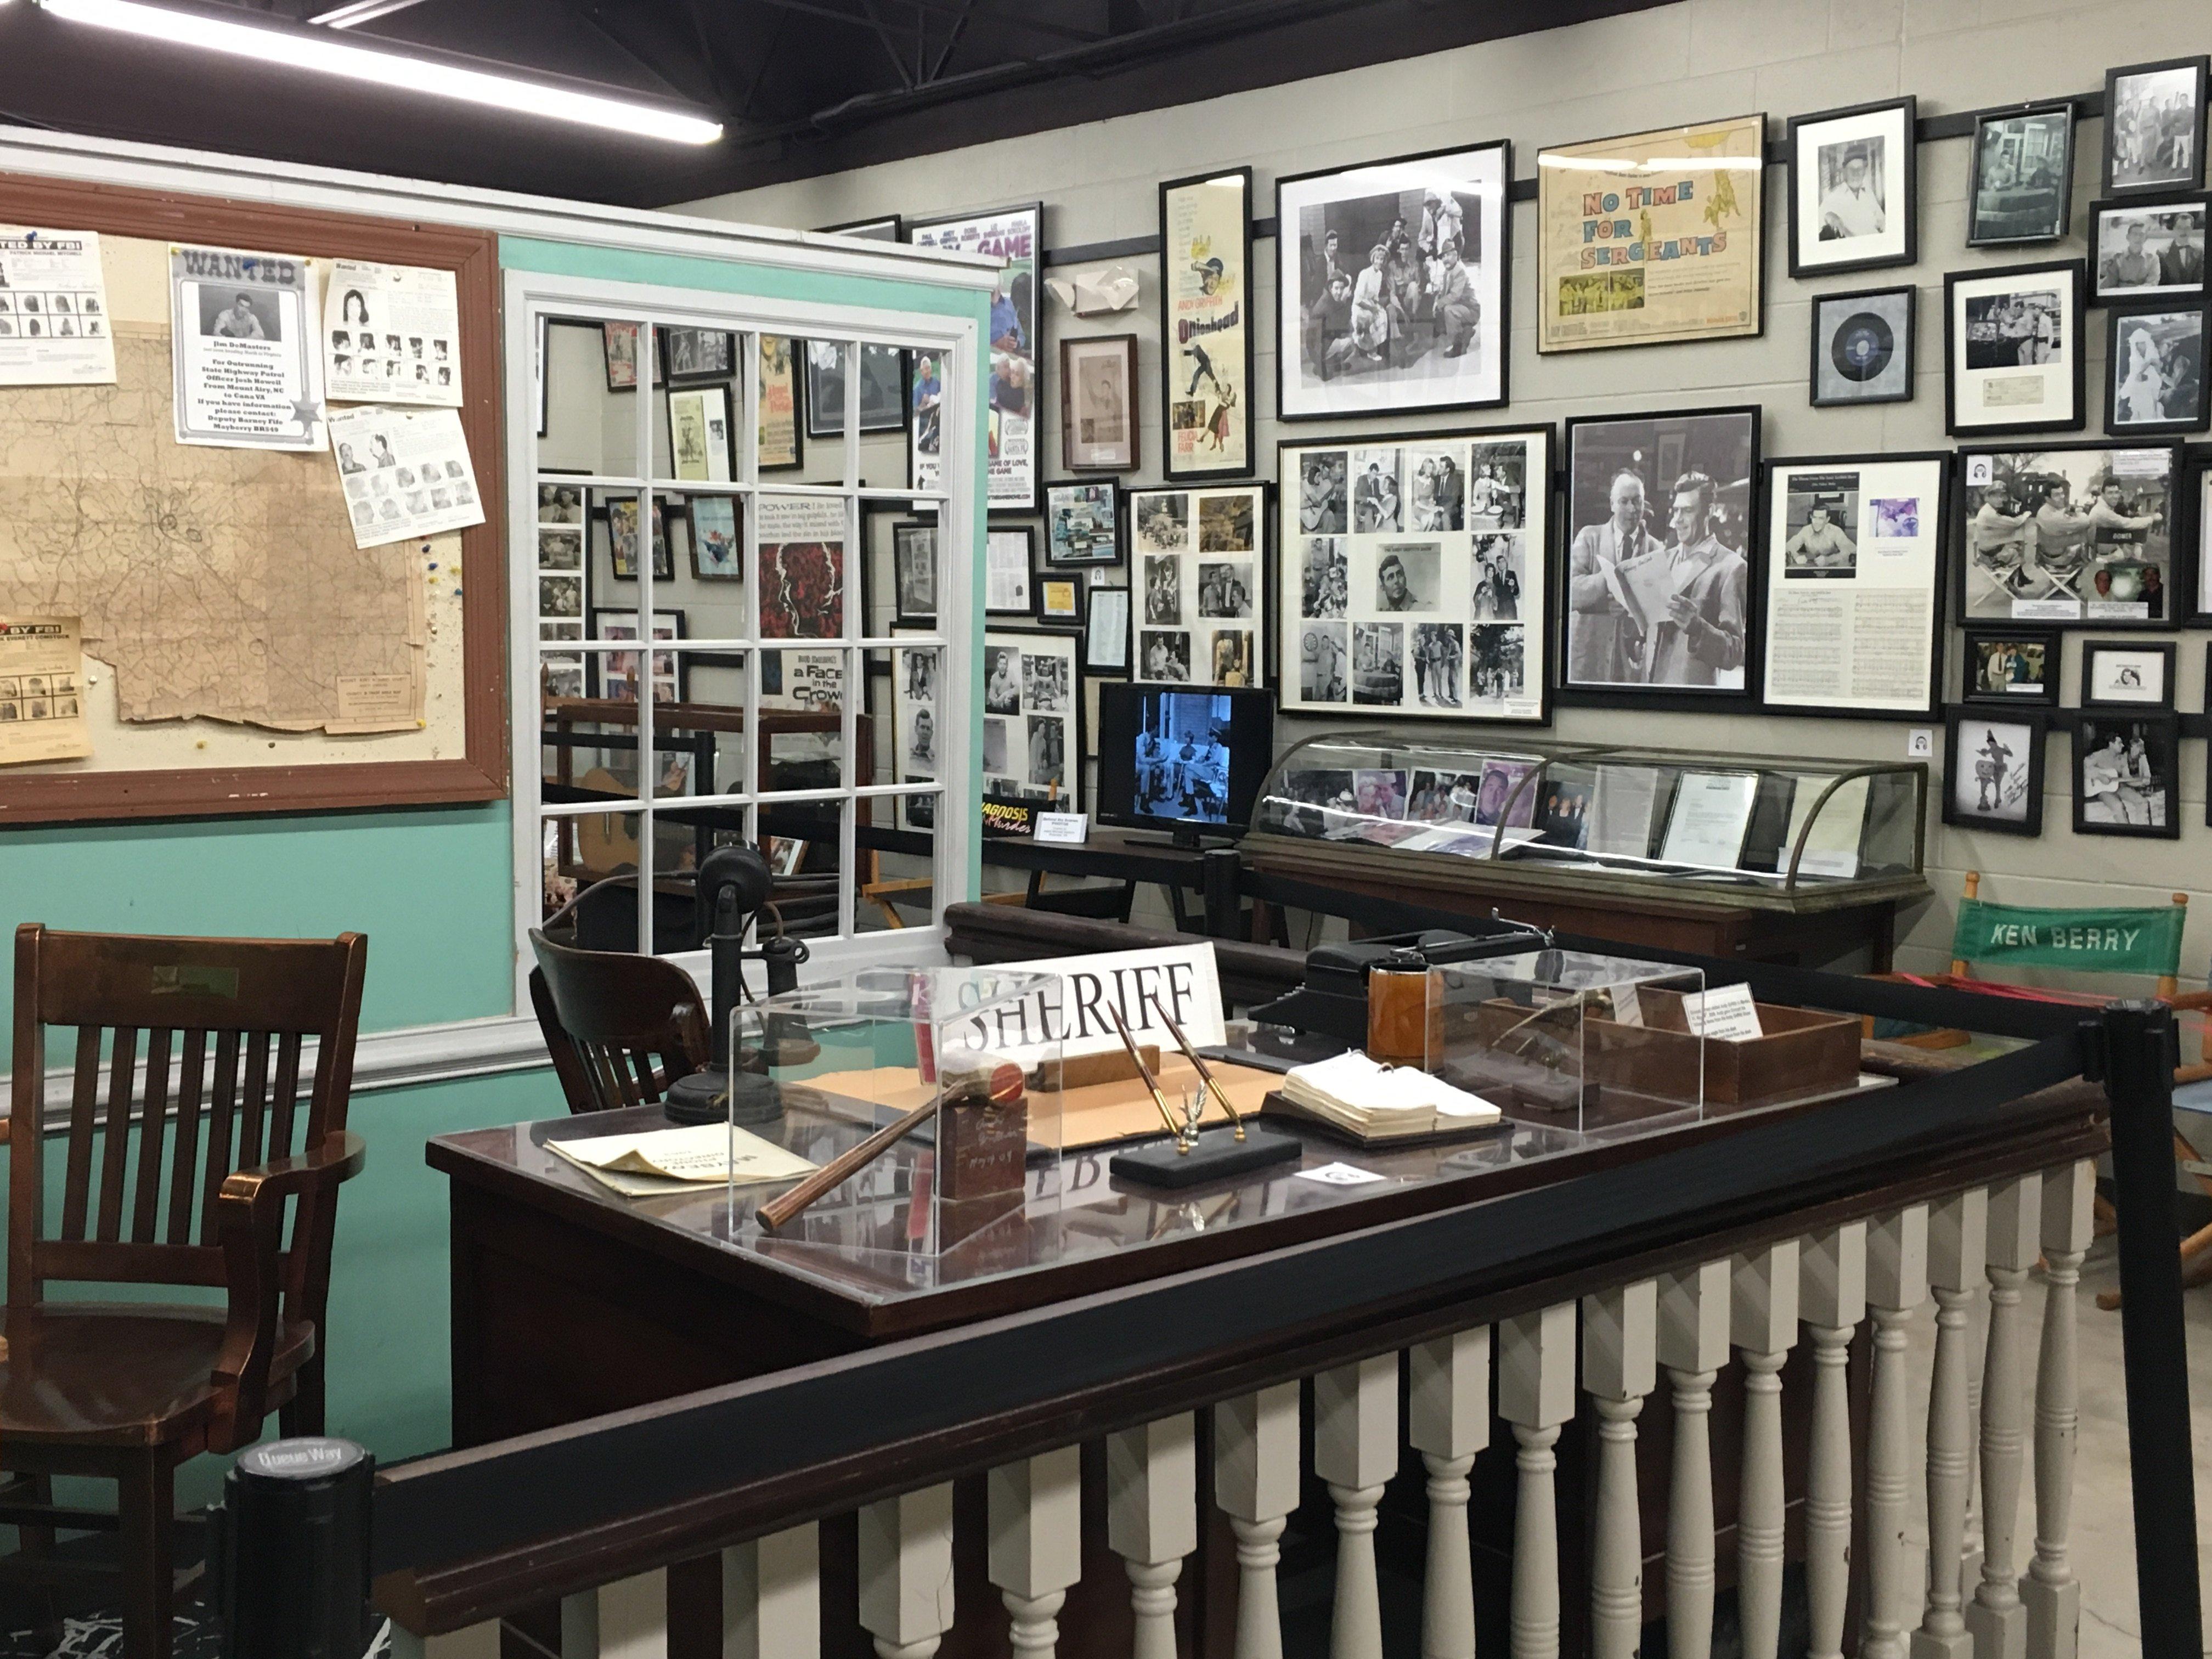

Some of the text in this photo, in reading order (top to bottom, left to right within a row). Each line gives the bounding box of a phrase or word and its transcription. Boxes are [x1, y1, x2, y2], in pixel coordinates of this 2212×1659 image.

[1583, 180, 1694, 216] NO TIME
[1583, 219, 1634, 243] FOR
[57, 242, 80, 250] FBI
[978, 234, 1031, 257] GAME
[1581, 231, 1727, 270] SERGEANTS
[182, 250, 296, 284] WANTED
[35, 625, 59, 634] FBI
[794, 668, 804, 678] a
[822, 680, 837, 689] the
[793, 686, 842, 704] Crow
[1990, 923, 2140, 951] KEN BERRY
[958, 962, 1194, 1052] SHERIFF
